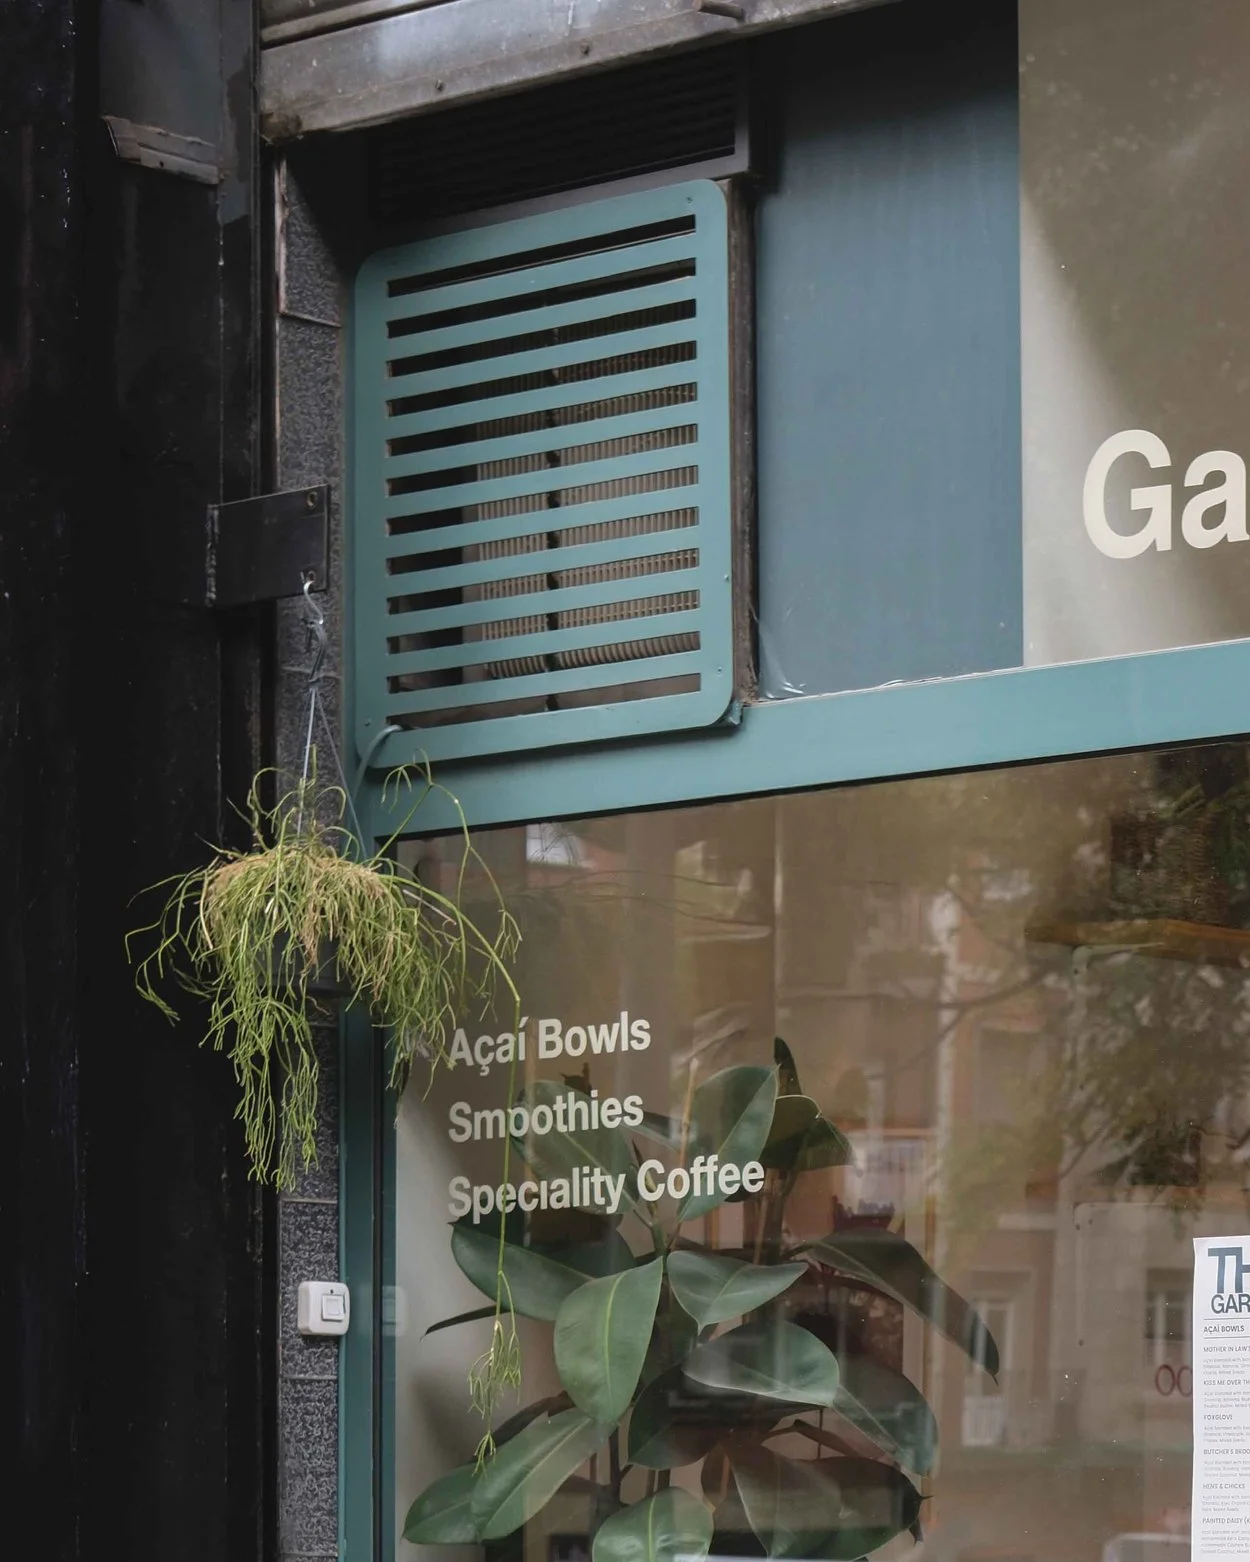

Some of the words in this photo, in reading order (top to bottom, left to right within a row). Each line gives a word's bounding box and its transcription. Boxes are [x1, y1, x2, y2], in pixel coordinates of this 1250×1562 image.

[449, 1015, 528, 1077] Açaí
[538, 1011, 652, 1060] Bowls
[448, 1090, 644, 1143] Smoothies
[448, 1166, 627, 1225] Speciality
[637, 1154, 765, 1202] Coffee
[1221, 1325, 1245, 1333] BOWLS
